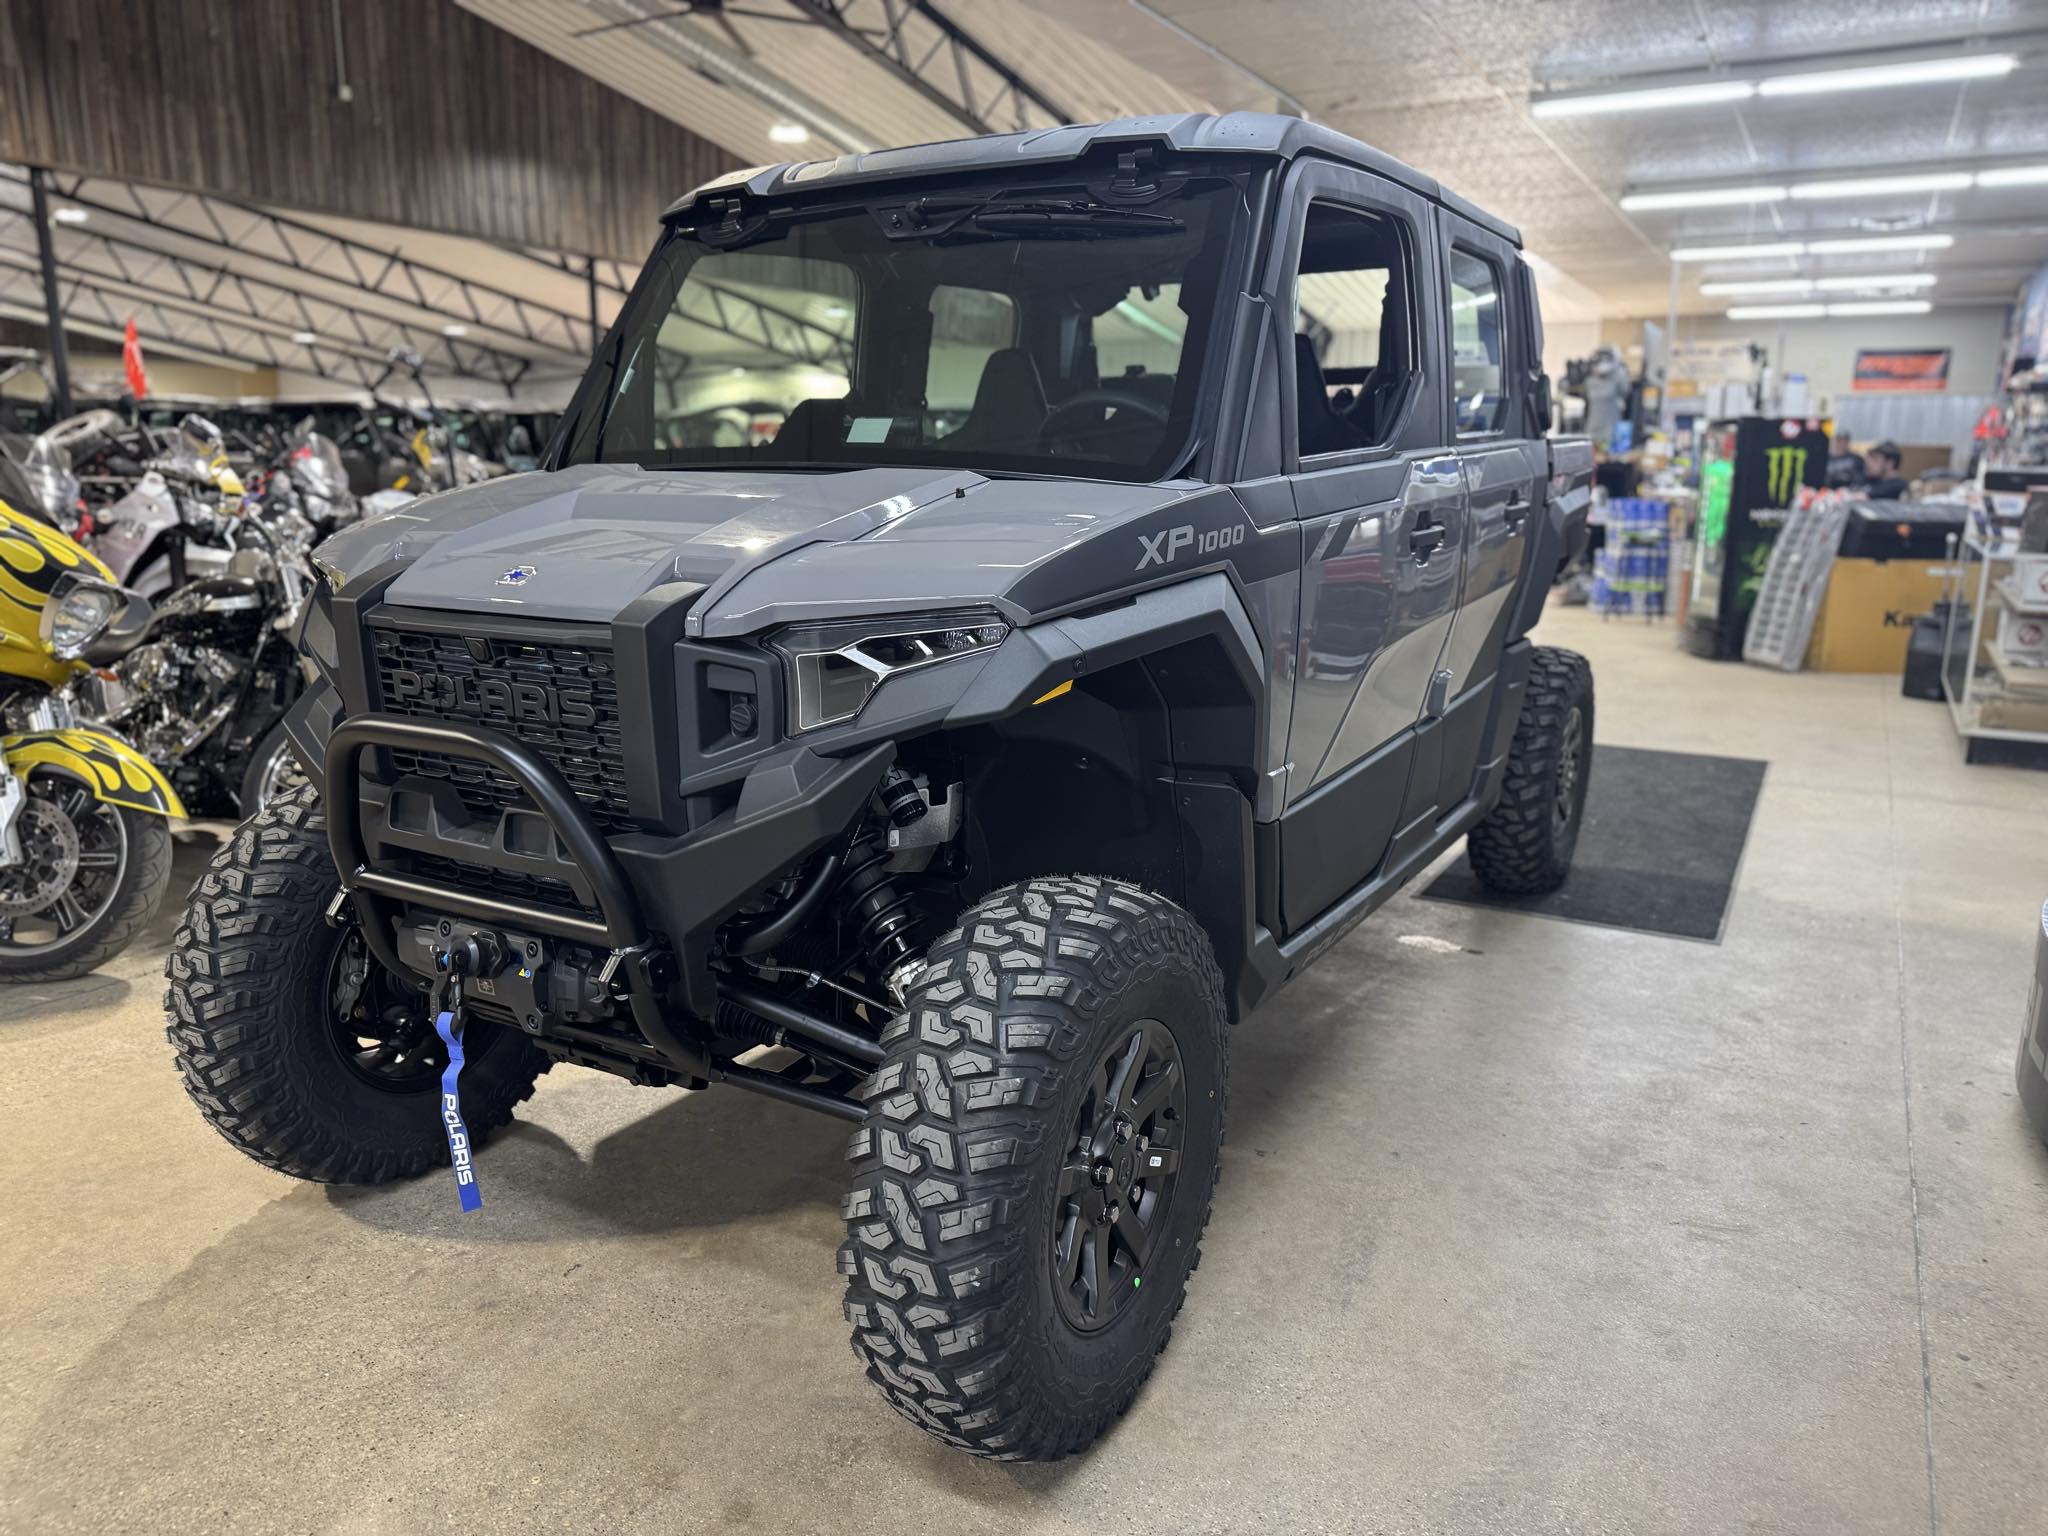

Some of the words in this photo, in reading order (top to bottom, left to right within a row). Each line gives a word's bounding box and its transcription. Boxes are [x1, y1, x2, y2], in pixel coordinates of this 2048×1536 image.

[1135, 524, 1194, 571] XP
[1198, 524, 1245, 554] 1000
[392, 669, 597, 727] POLARIS
[444, 1093, 474, 1186] POLARIS
